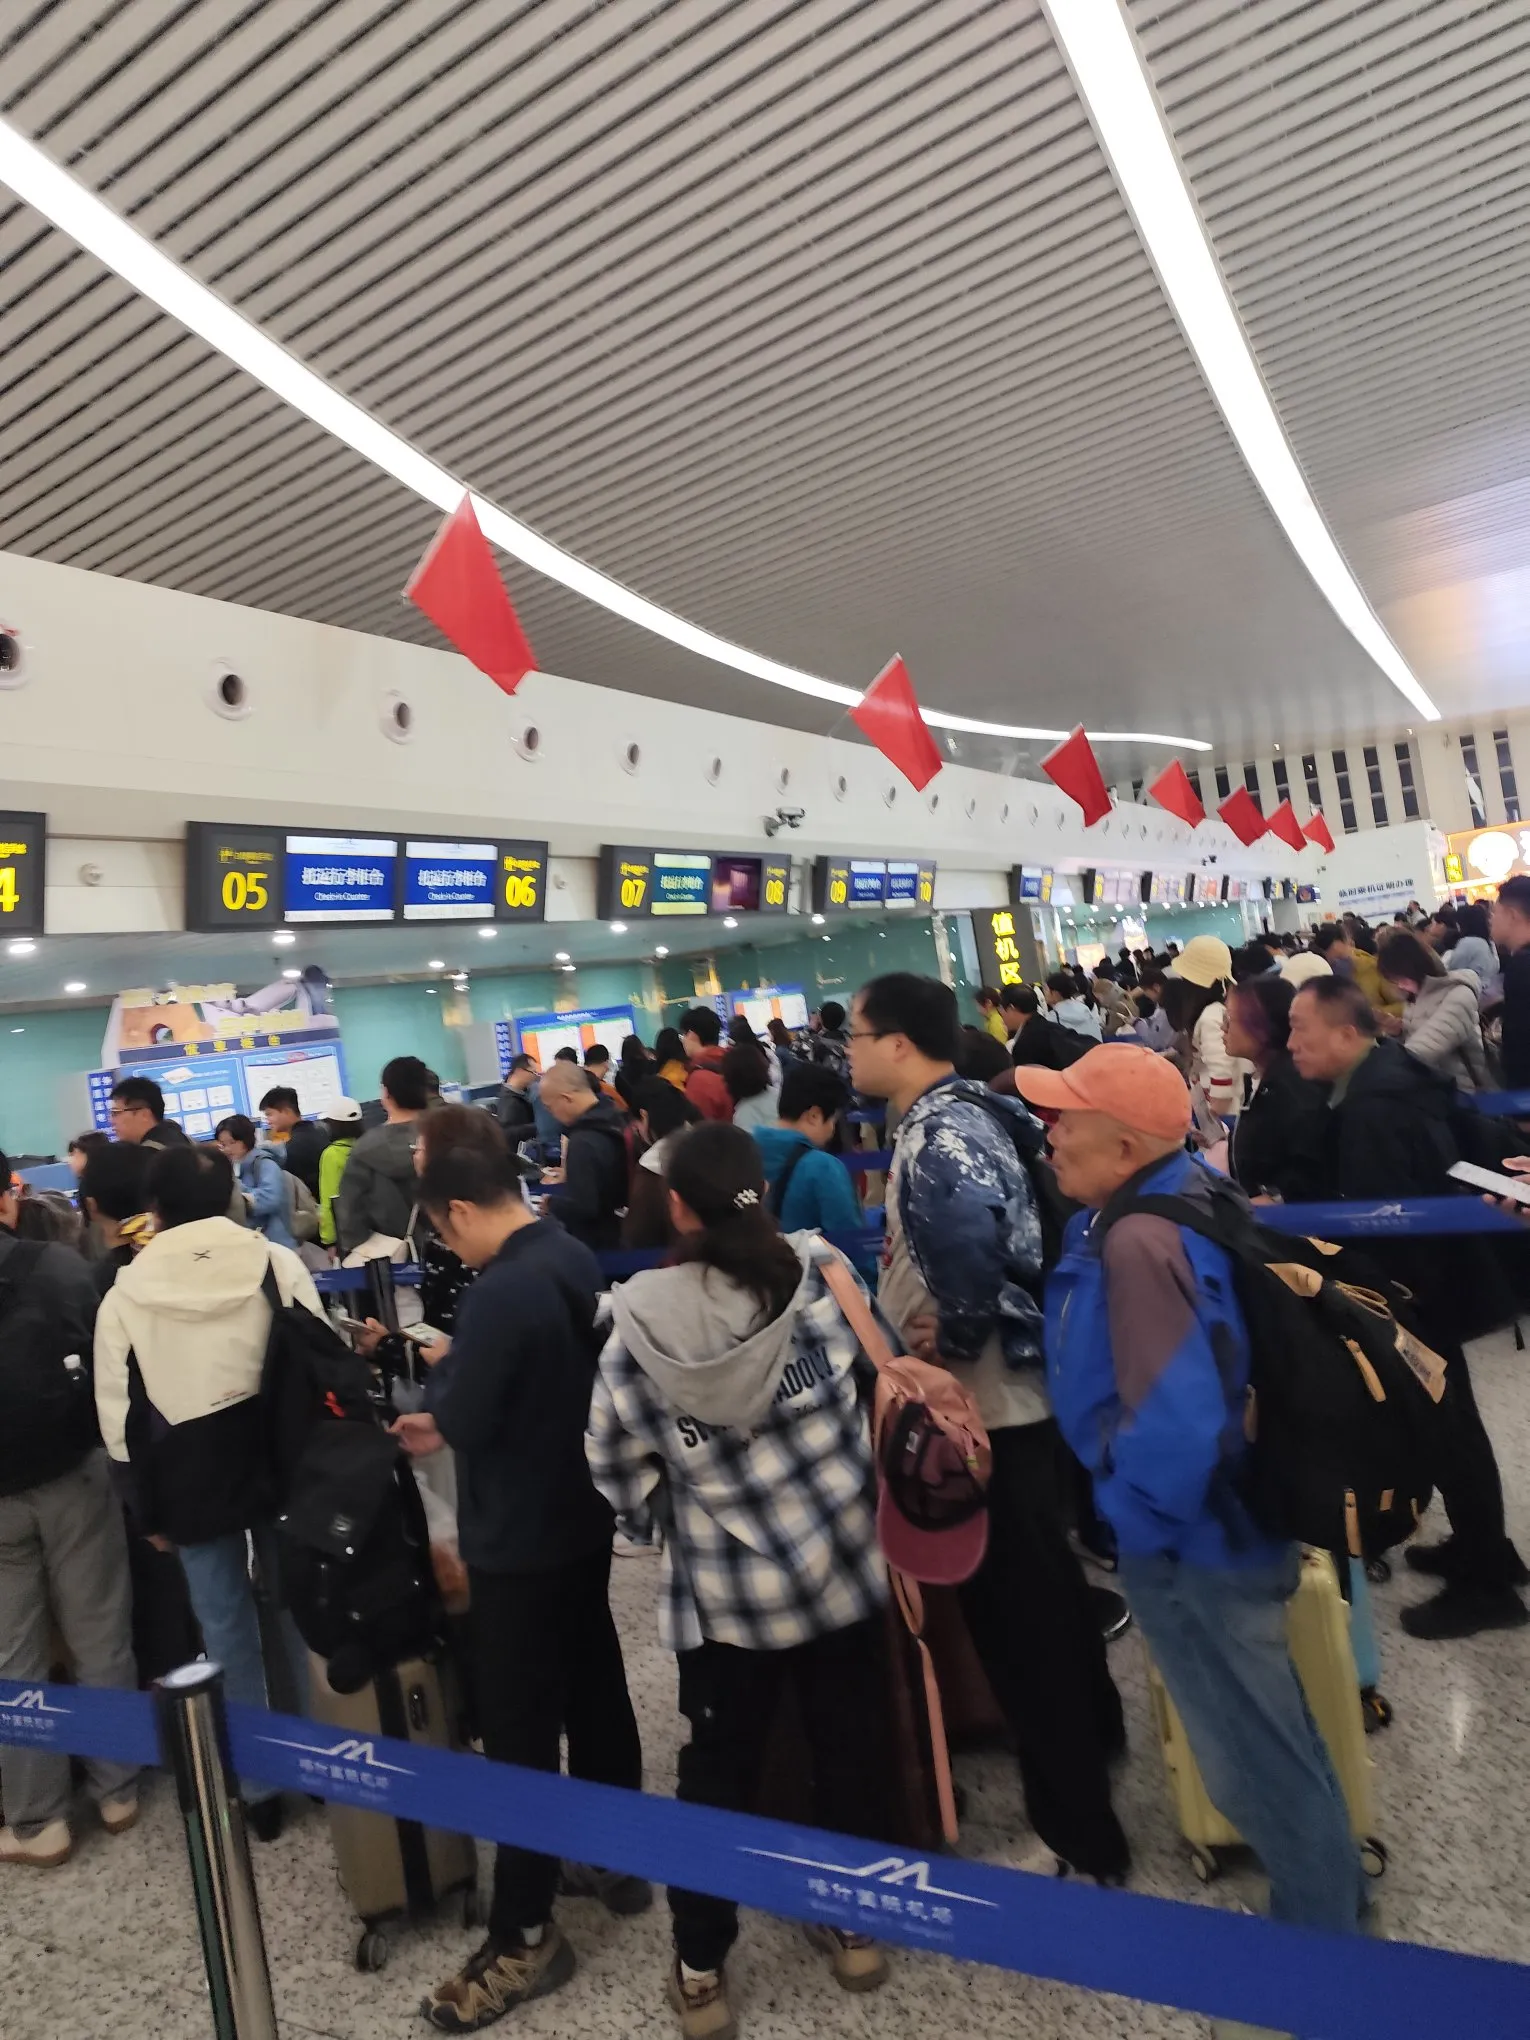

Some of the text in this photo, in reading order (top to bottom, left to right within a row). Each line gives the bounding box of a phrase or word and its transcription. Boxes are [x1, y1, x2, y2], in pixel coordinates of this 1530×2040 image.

[221, 871, 269, 910] 05
[505, 875, 537, 908] 06
[621, 879, 646, 908] 07
[766, 879, 785, 905] 08
[991, 911, 1023, 986] 值机区
